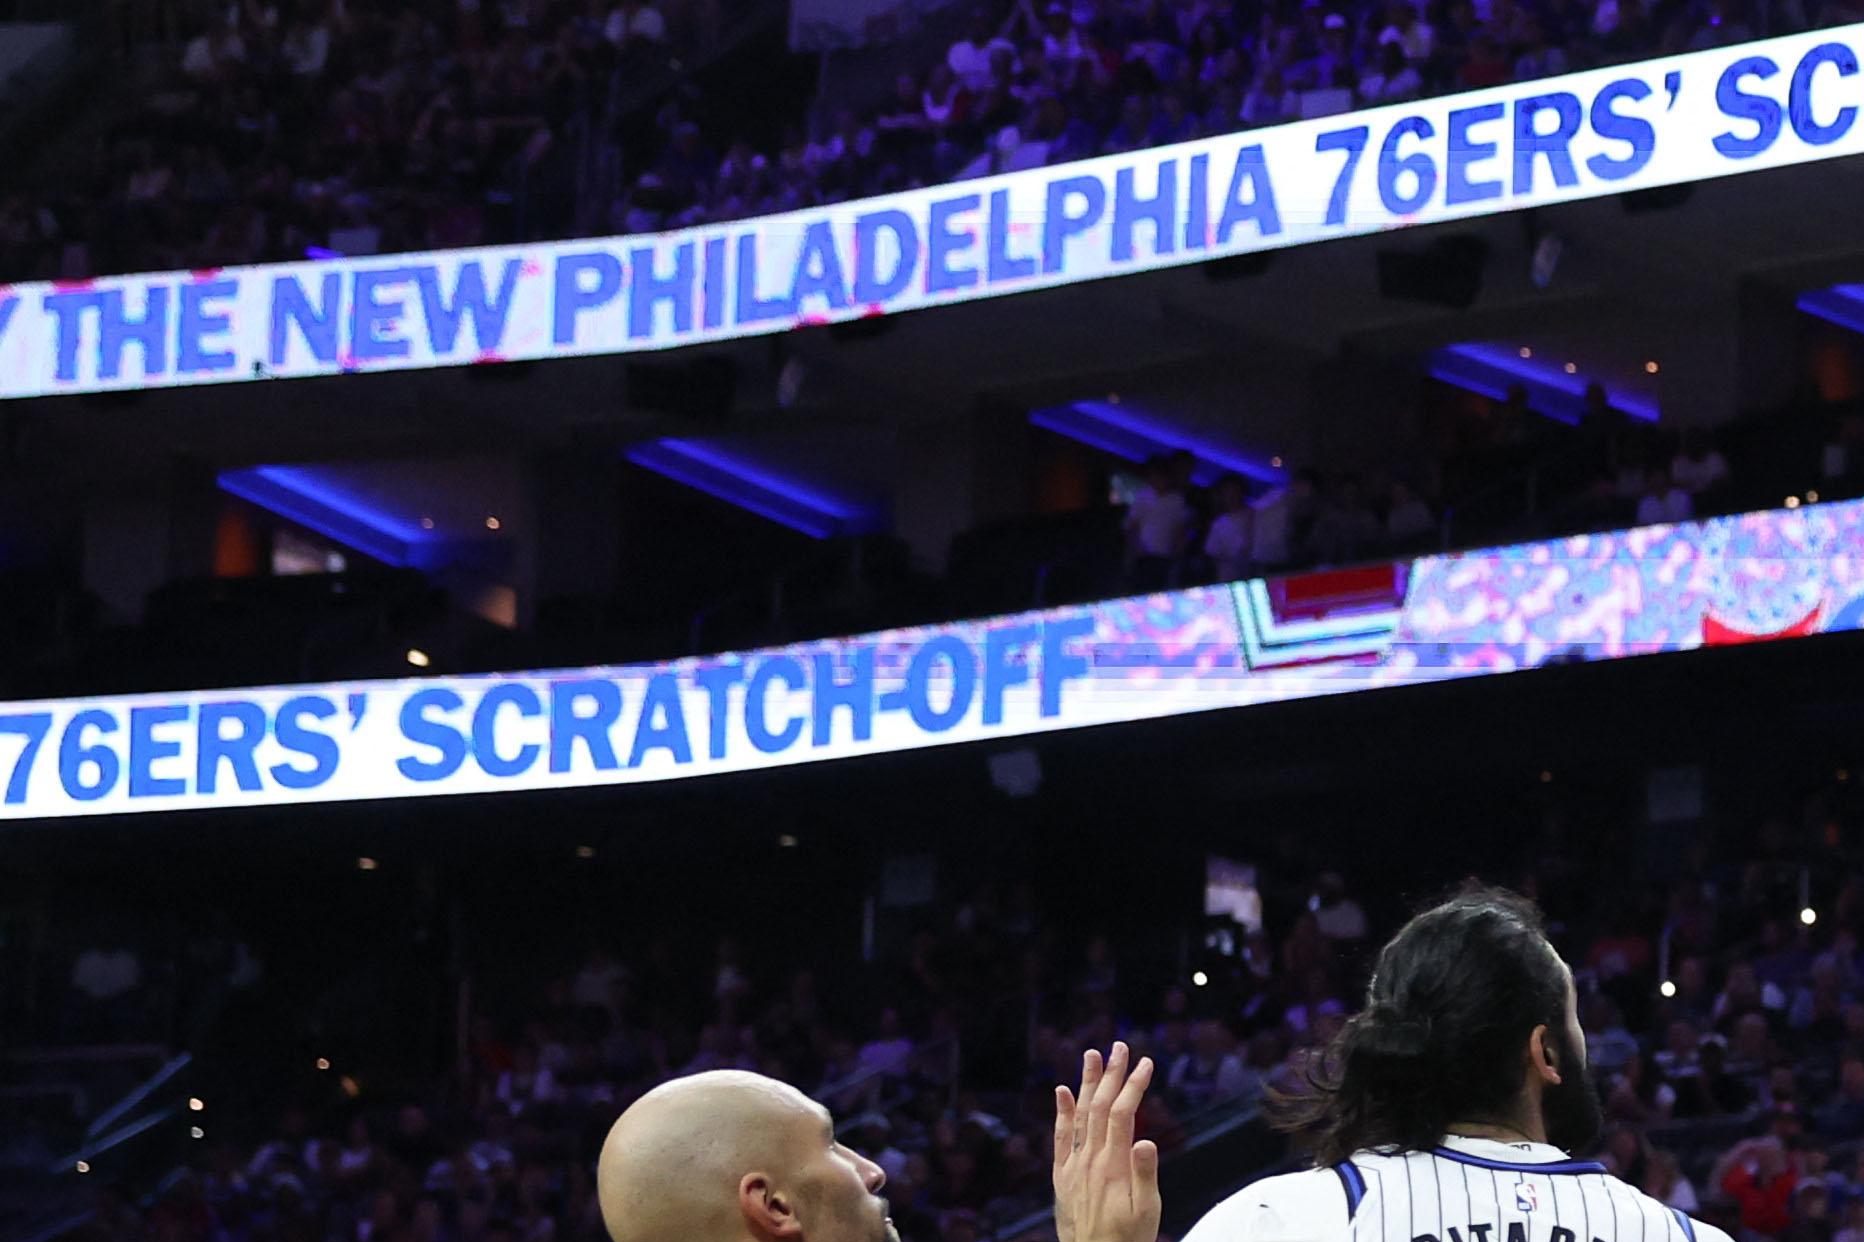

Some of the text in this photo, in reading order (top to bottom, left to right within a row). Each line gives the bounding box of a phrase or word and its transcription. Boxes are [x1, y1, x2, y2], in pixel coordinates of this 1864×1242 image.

[43, 278, 240, 382] THE
[270, 257, 524, 368] NEW
[552, 144, 1283, 344] PHILADELPHIA
[1315, 72, 1683, 228] 76ERS'
[0, 614, 1097, 804] 76ERS' SCRATCH-OFF
